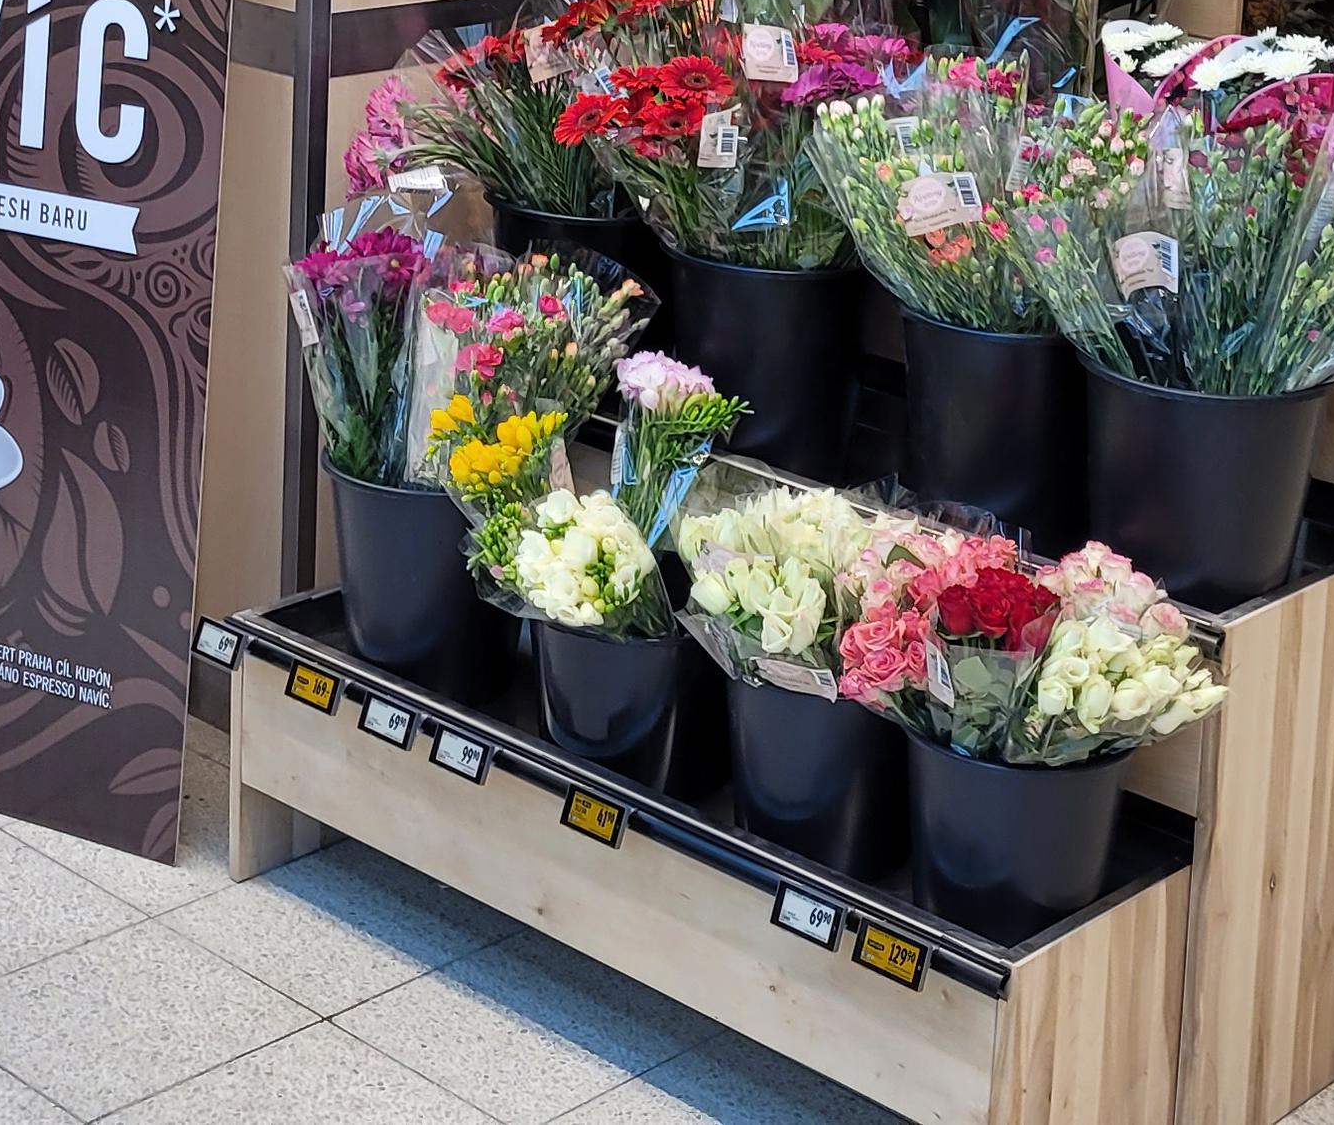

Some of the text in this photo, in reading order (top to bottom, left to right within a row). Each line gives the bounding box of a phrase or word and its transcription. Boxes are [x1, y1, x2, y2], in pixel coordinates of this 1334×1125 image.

[39, 203, 89, 231] BARU
[18, 649, 53, 674] PRAHA
[55, 658, 72, 678] CÍL
[75, 664, 114, 691] KUPÓN,
[22, 671, 76, 700] ESPRESSO
[78, 684, 113, 710] NAVÍC.
